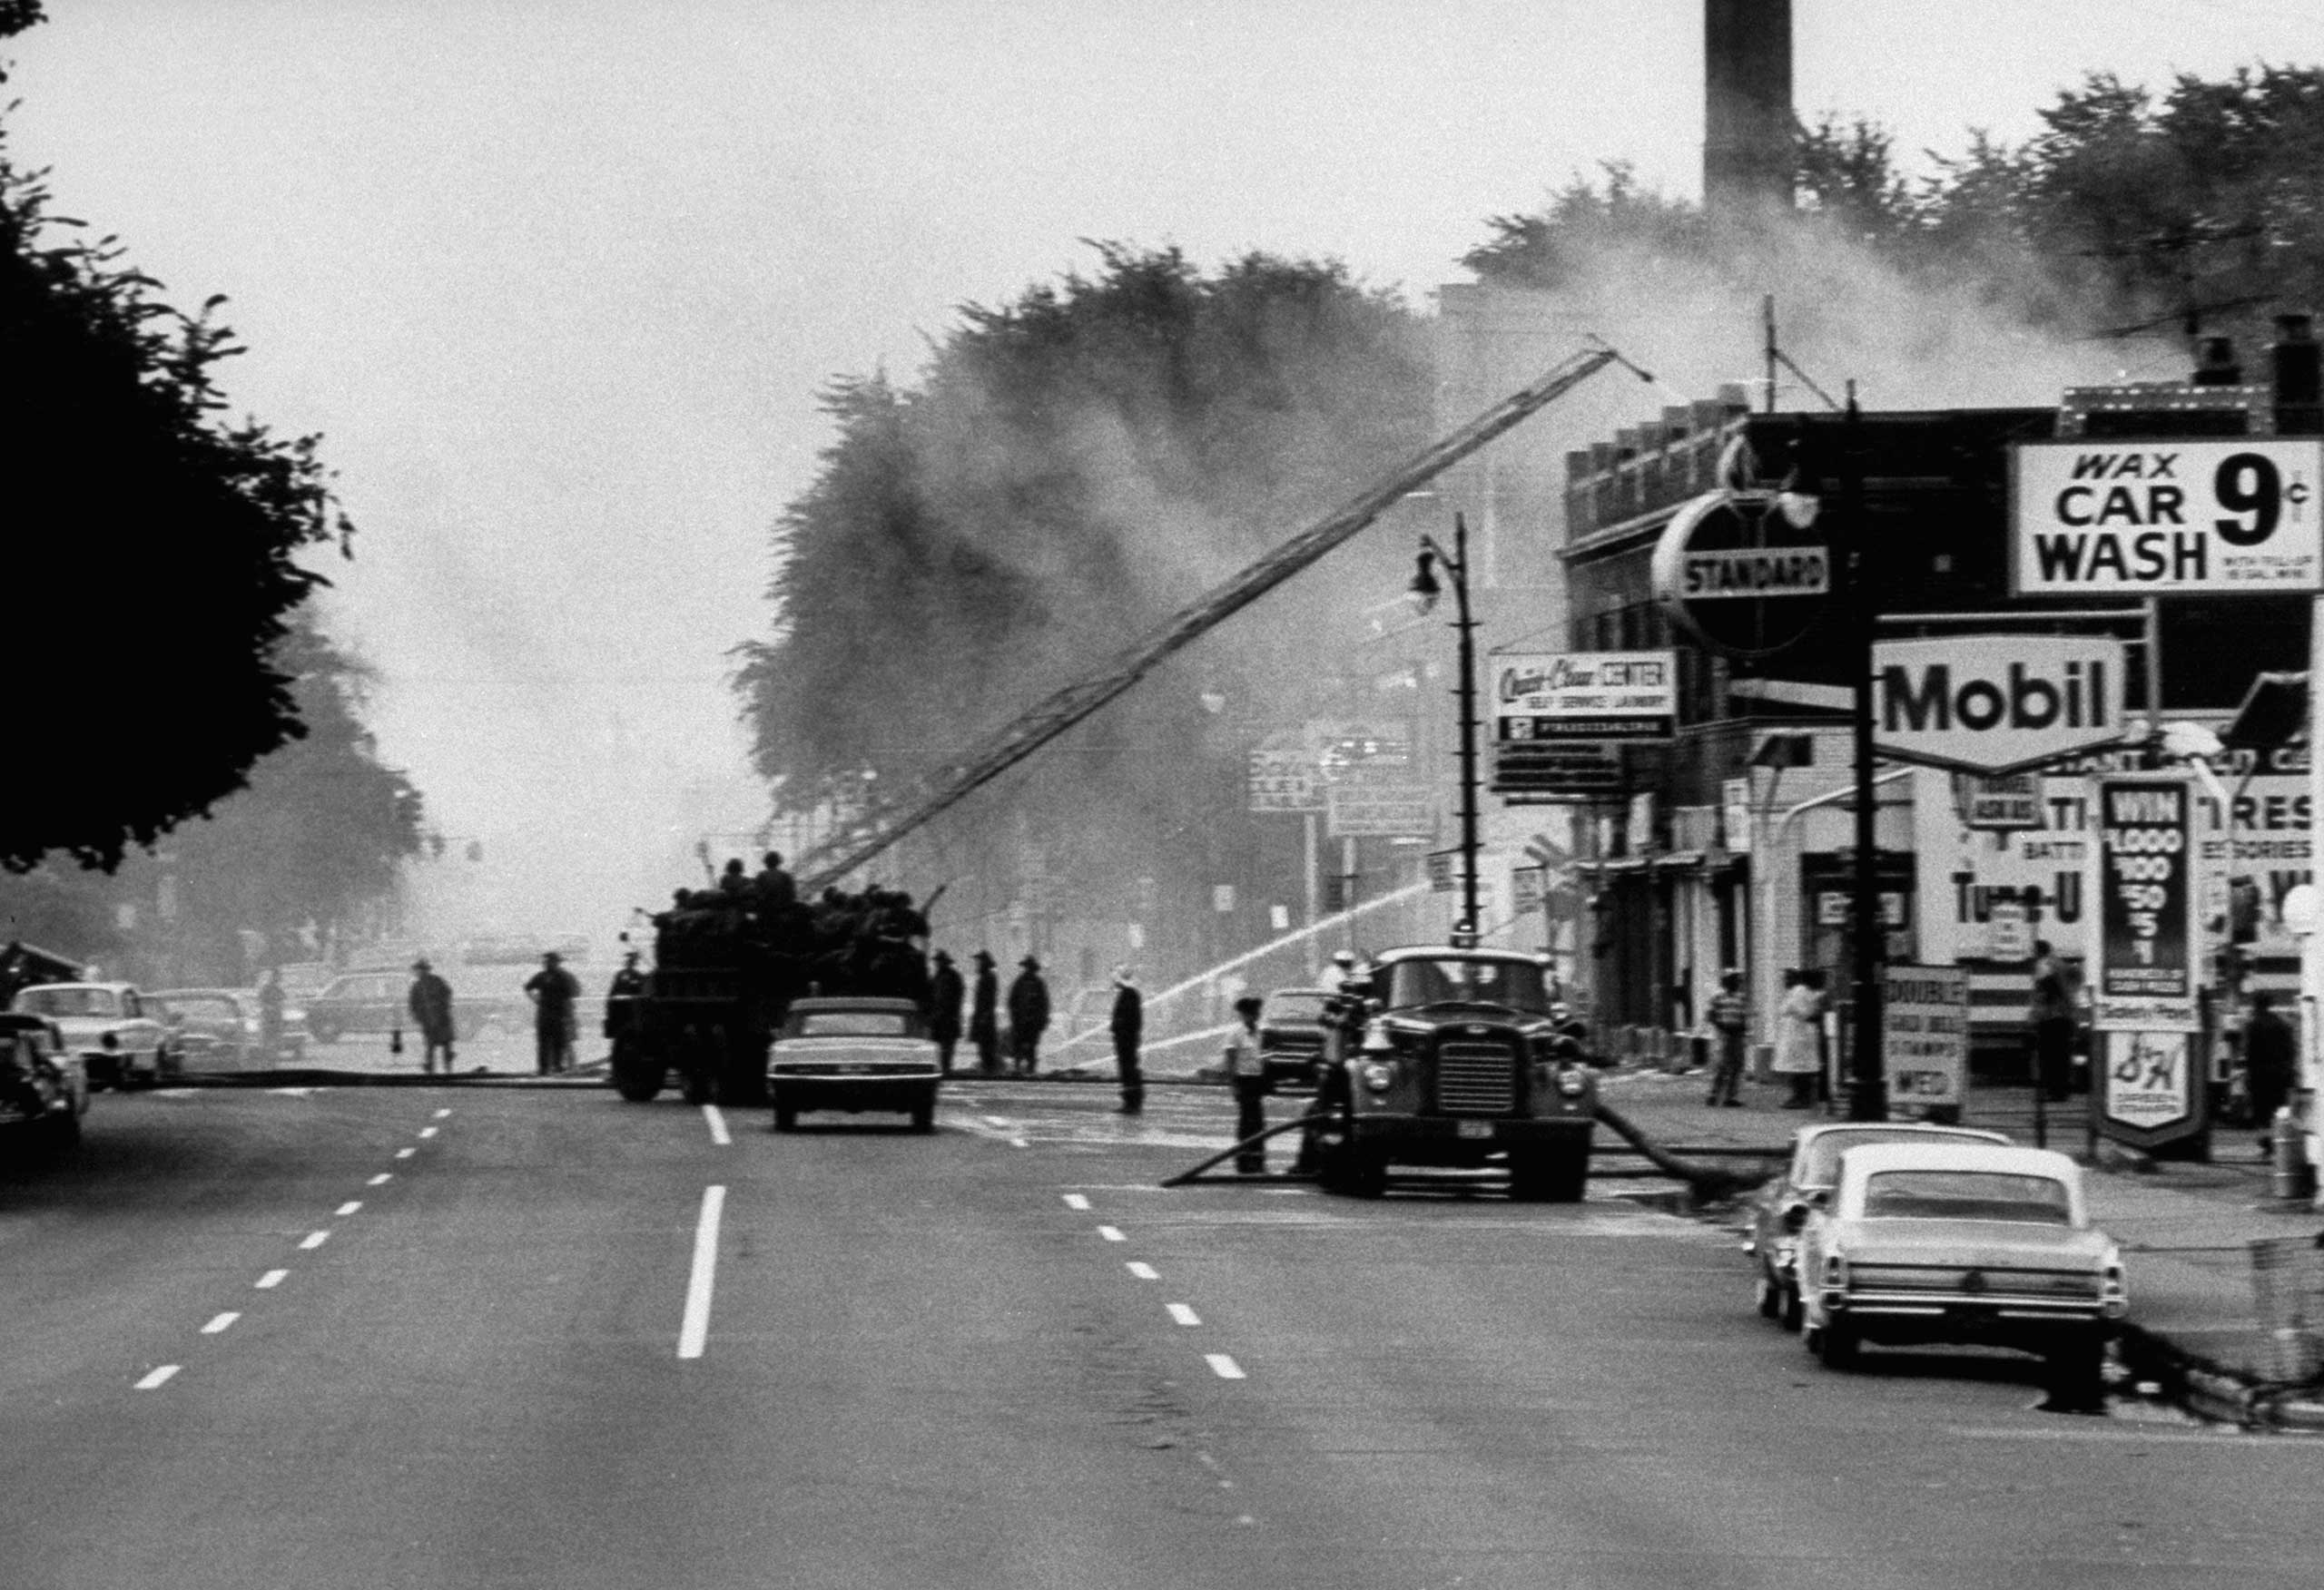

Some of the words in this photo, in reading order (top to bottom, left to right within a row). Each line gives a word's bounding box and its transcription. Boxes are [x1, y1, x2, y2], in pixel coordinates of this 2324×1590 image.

[2073, 454, 2177, 479] WAX
[2056, 486, 2185, 526] CAR
[1686, 555, 1822, 593] STANDARD
[2035, 532, 2206, 582] WASH
[1884, 662, 2103, 731] Mobil
[2112, 791, 2178, 822] WIN
